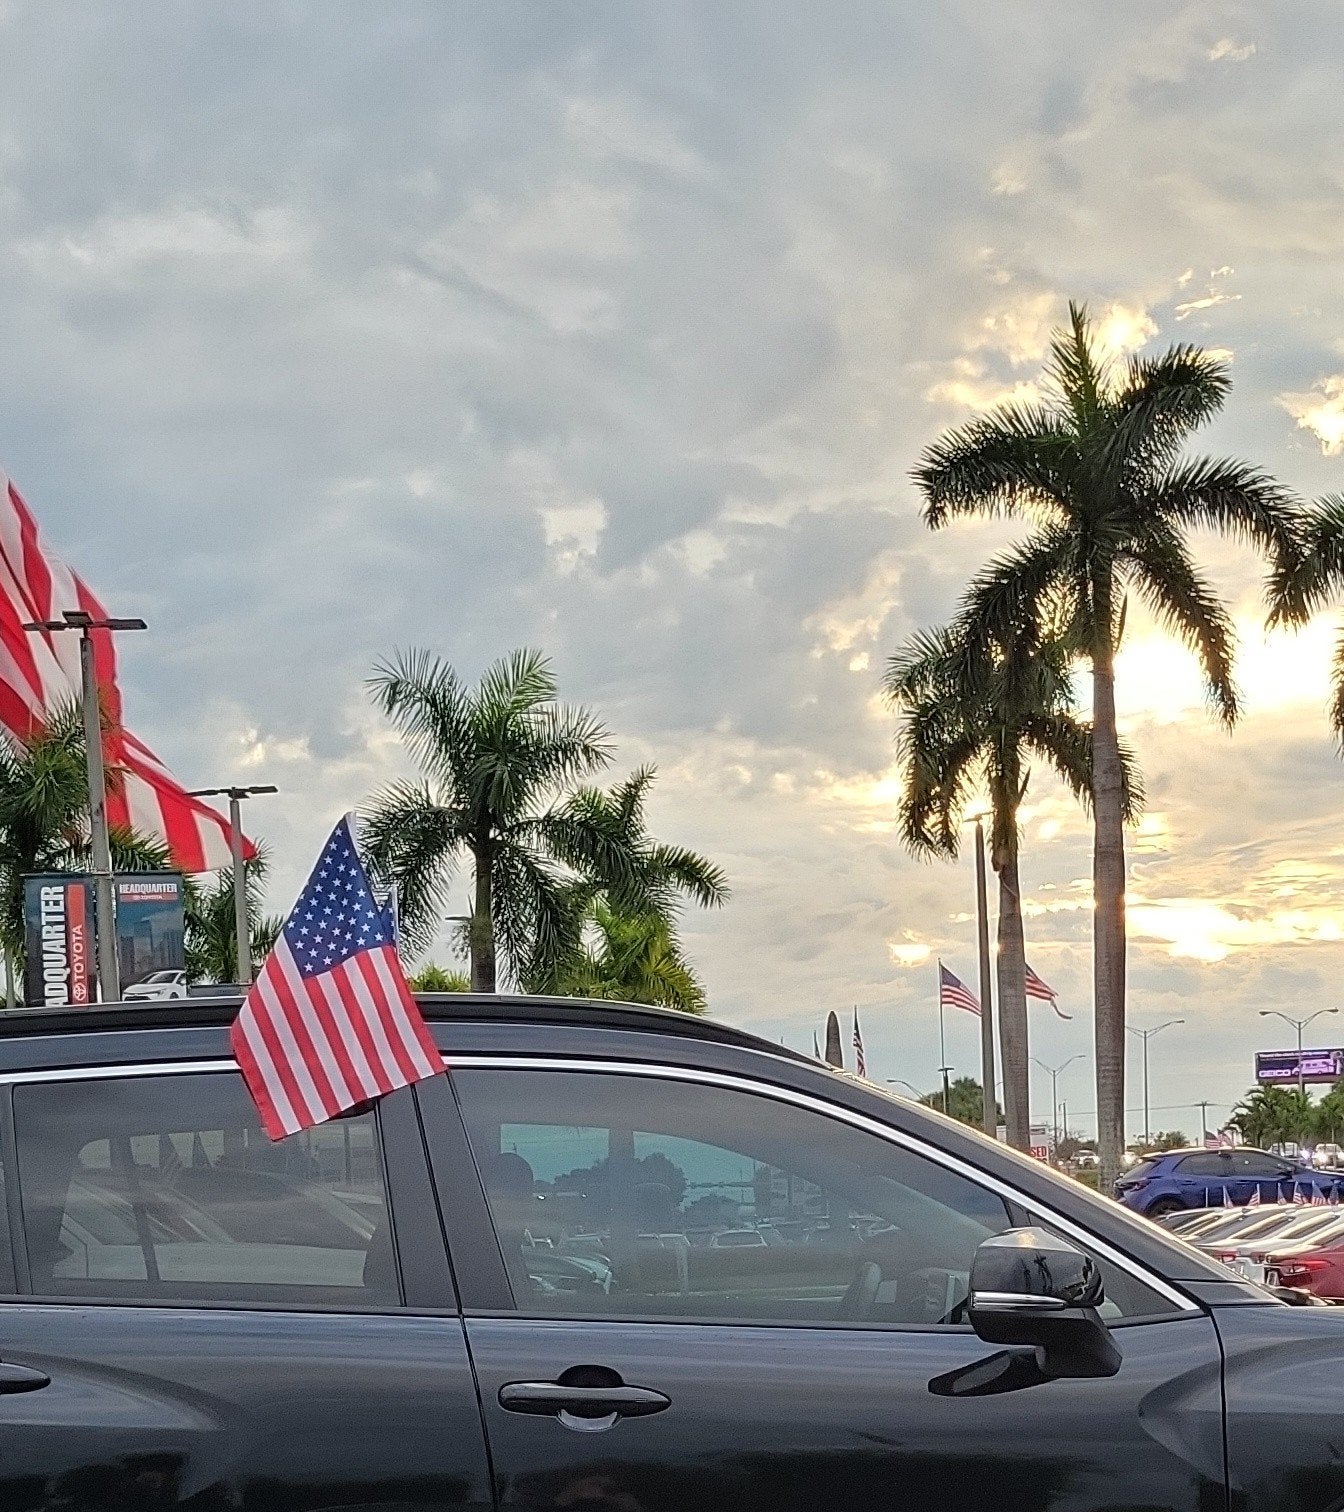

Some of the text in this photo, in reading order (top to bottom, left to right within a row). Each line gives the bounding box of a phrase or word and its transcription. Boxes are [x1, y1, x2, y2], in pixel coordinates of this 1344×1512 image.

[119, 883, 178, 894] HEADQUARTER
[40, 886, 71, 1007] ADQUARTER
[72, 924, 85, 981] TOYOTA
[1030, 1145, 1047, 1157] SED
